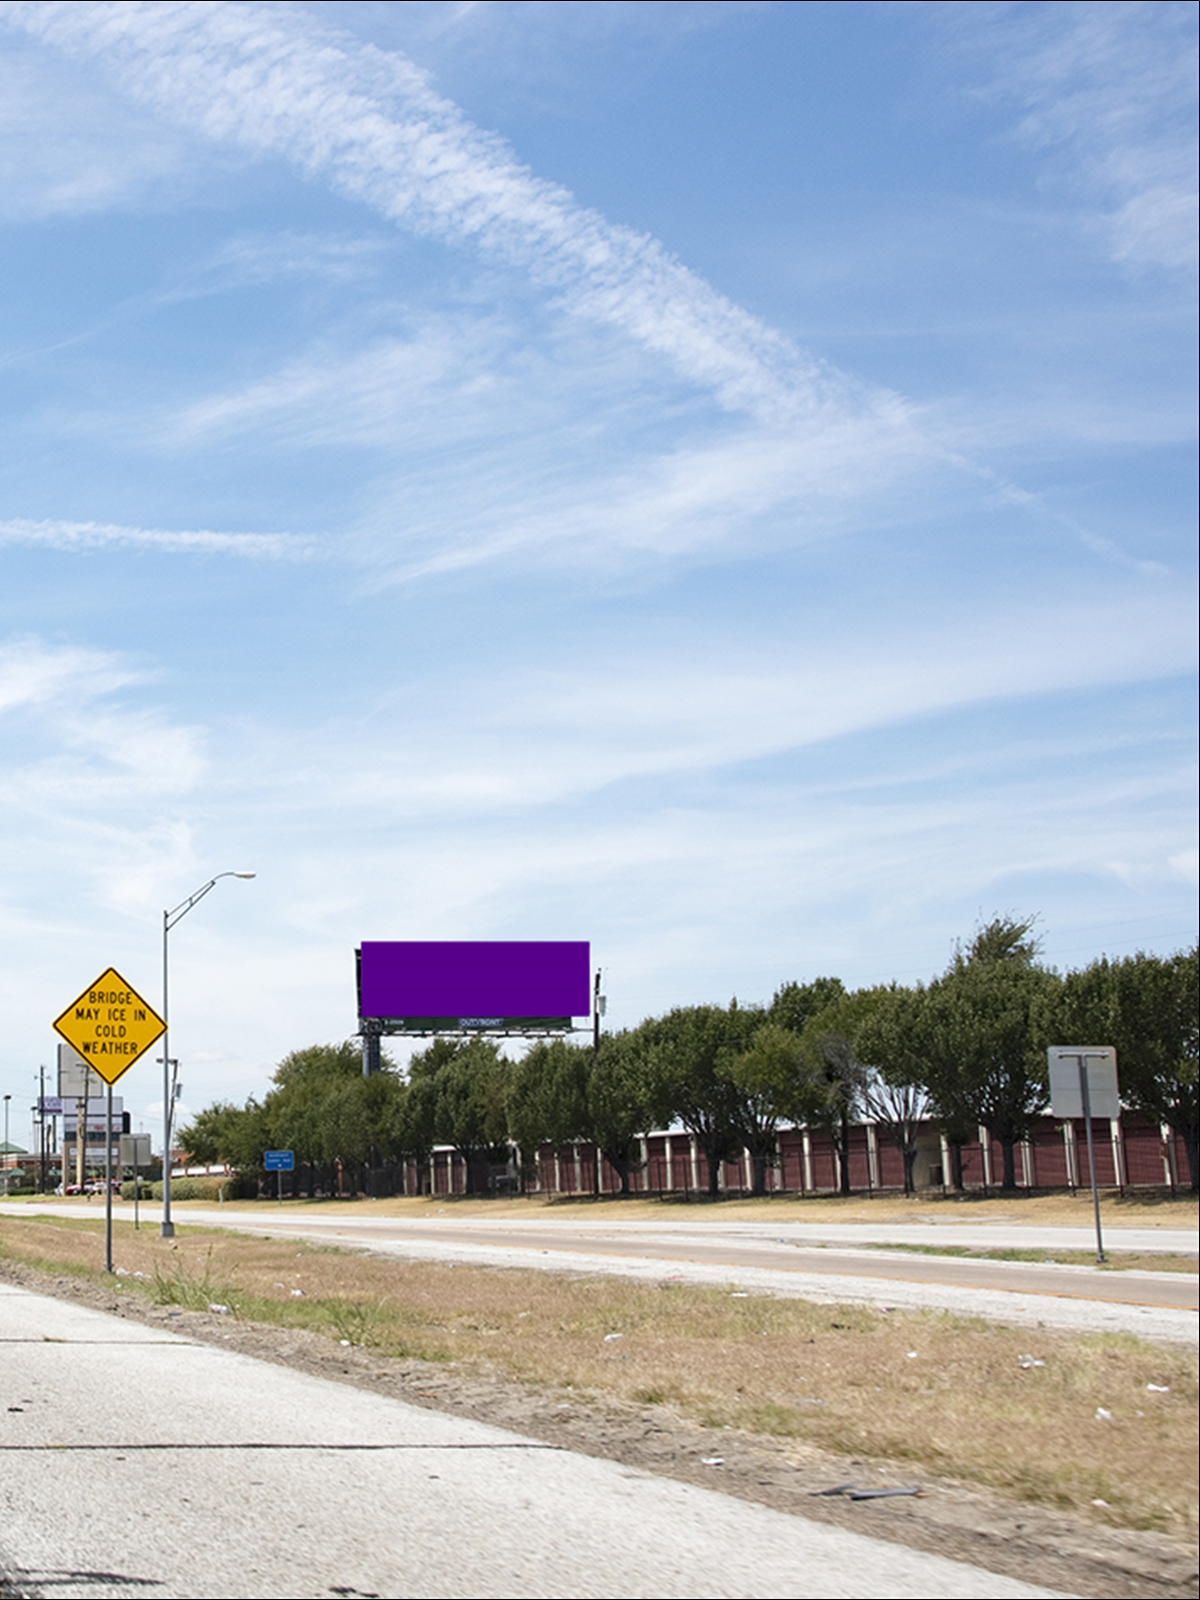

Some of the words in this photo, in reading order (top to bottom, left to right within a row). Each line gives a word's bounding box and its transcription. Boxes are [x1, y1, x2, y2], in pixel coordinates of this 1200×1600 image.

[88, 991, 133, 1005] BRIDGE
[75, 1008, 100, 1020] MAY
[107, 1008, 126, 1021] ICE
[134, 1009, 147, 1021] IN
[95, 1025, 127, 1038] COLD
[82, 1041, 138, 1055] WEATHER
